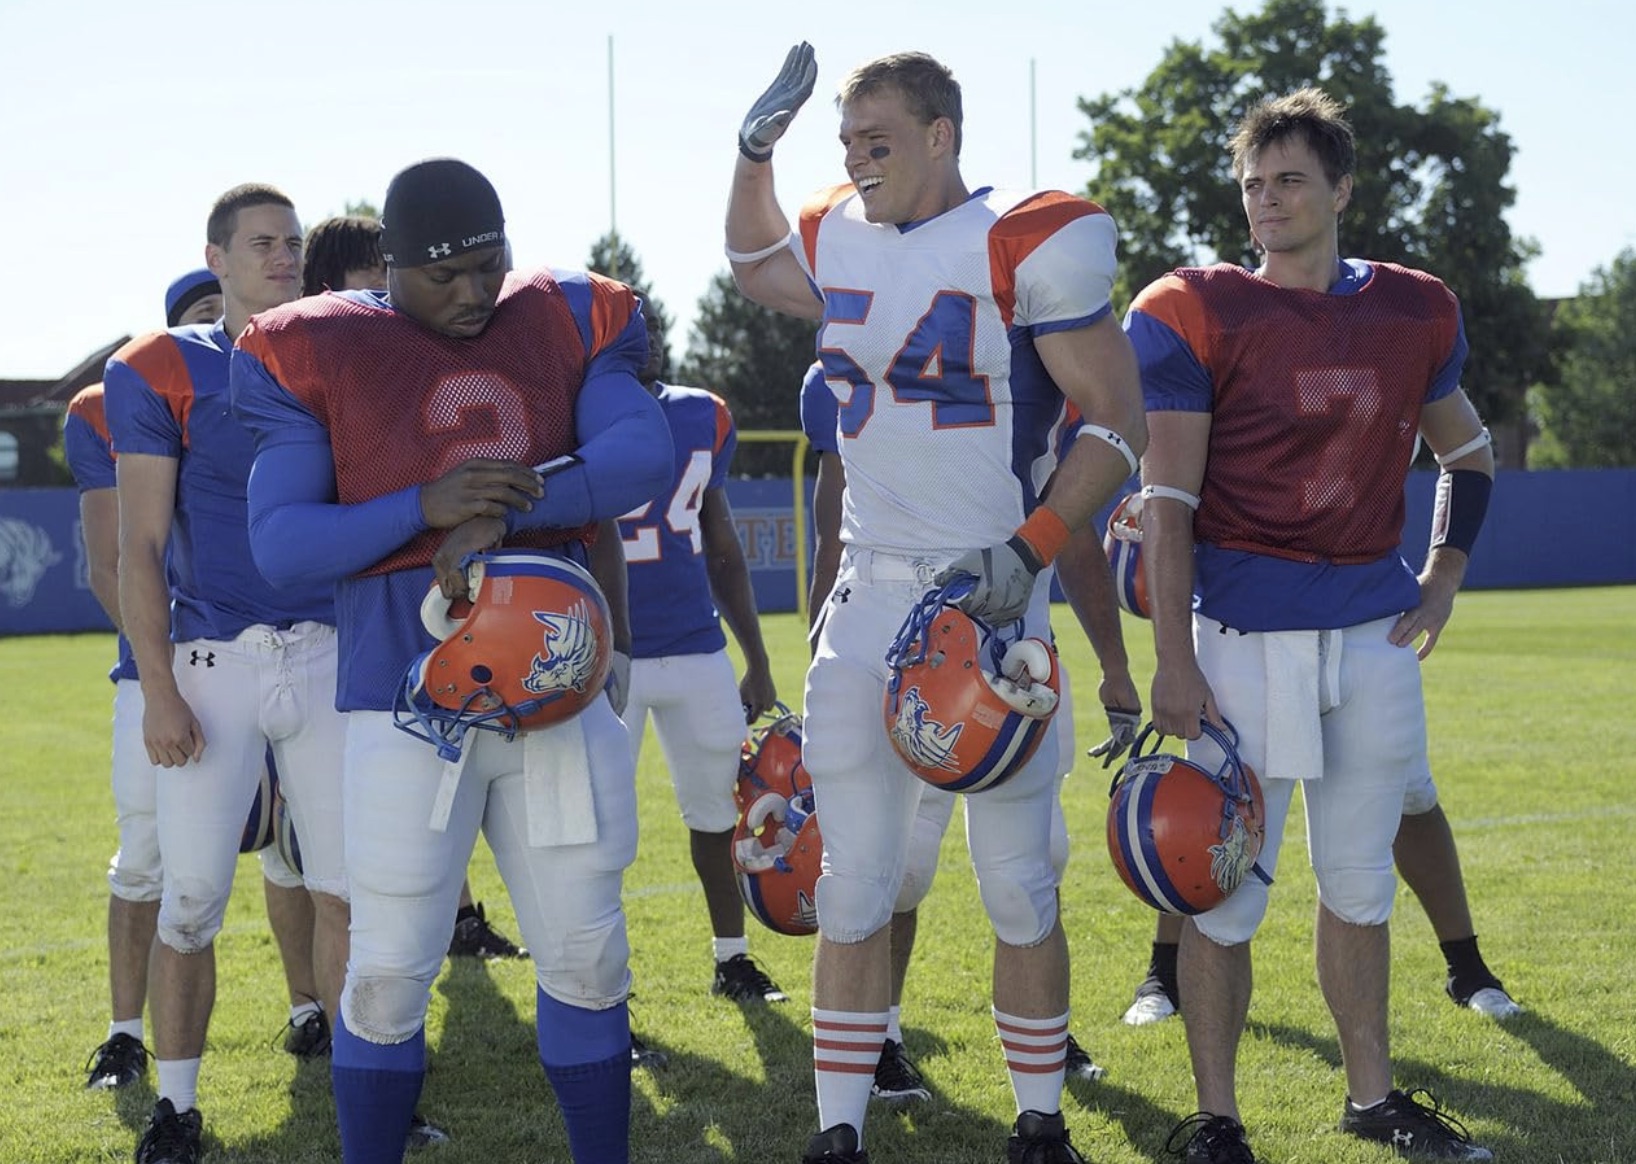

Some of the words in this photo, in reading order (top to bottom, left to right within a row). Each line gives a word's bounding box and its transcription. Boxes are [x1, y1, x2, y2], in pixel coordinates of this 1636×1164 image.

[462, 231, 498, 247] UNDER
[818, 287, 996, 439] 54
[1294, 367, 1382, 511] 7
